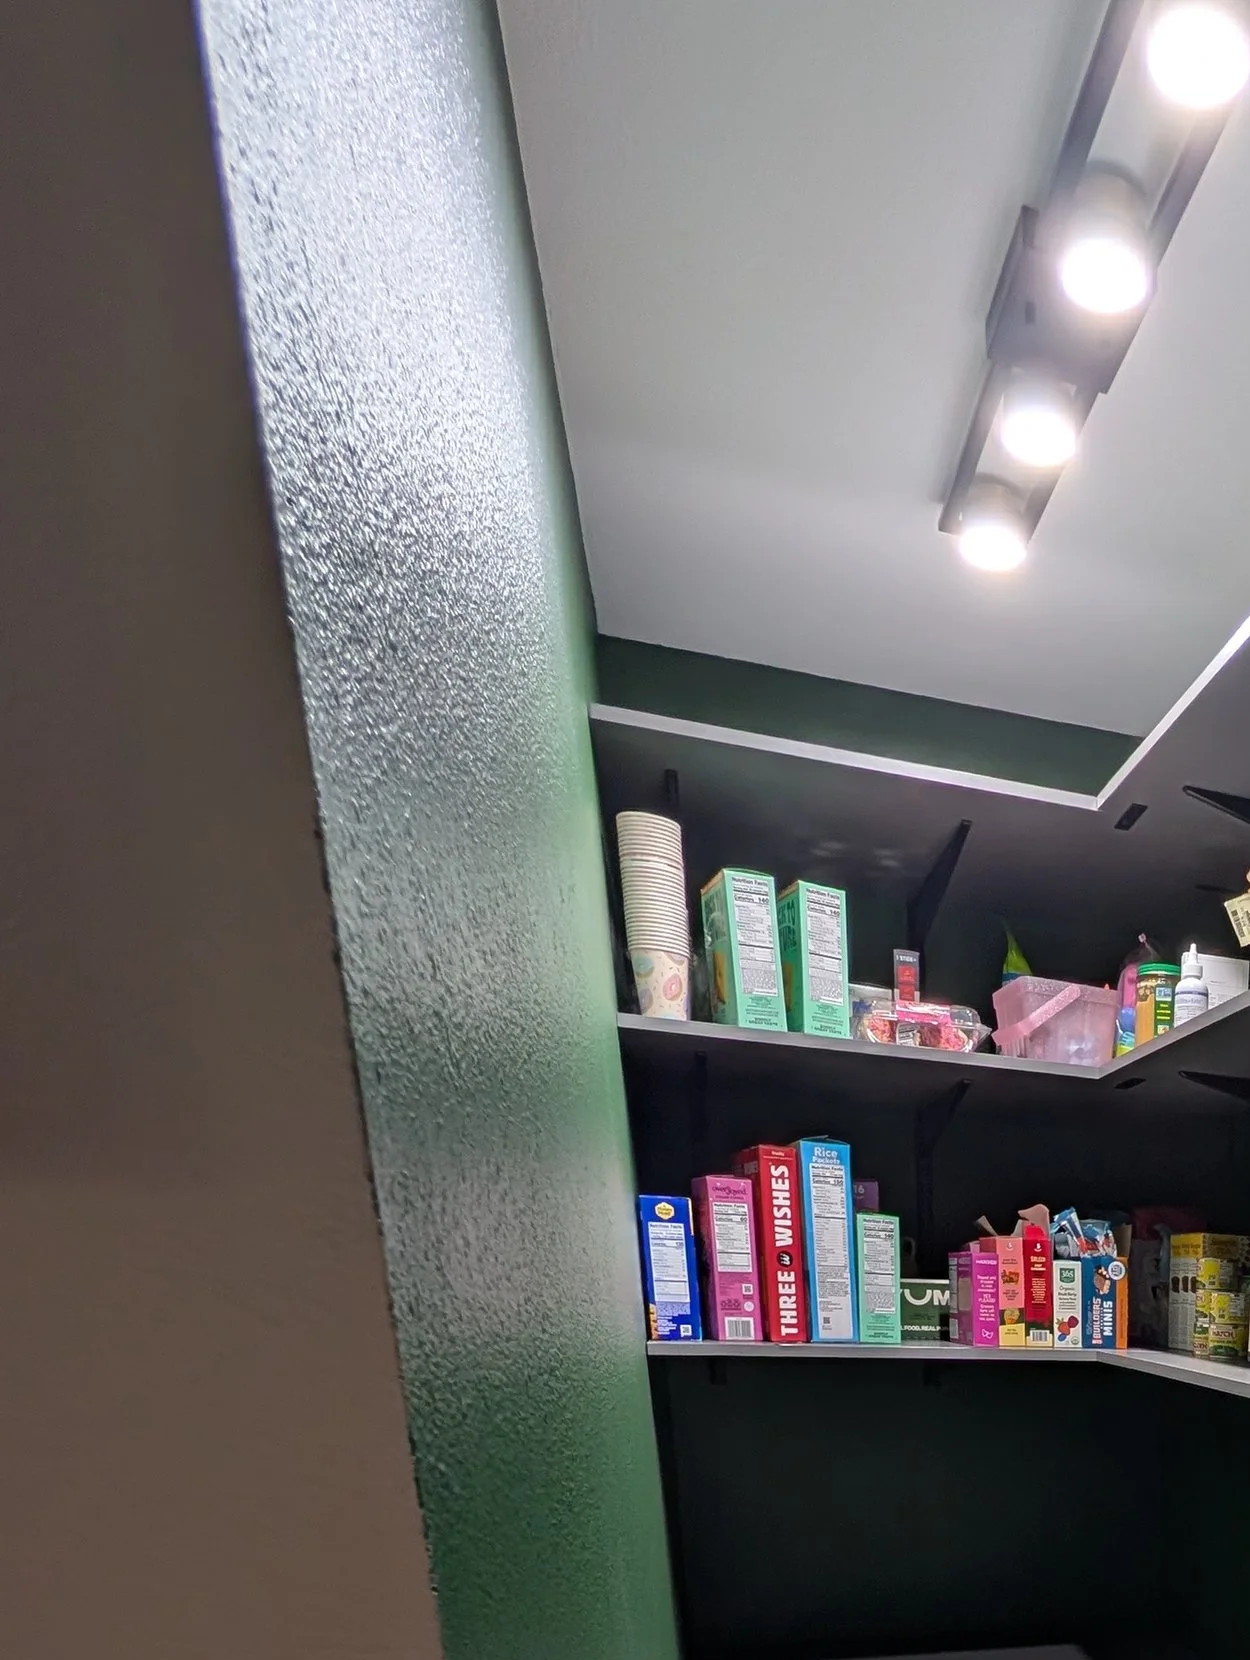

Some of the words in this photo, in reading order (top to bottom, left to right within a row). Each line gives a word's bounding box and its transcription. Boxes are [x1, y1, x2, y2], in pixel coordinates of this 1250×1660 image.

[813, 1146, 838, 1158] Rice
[770, 1164, 793, 1248] WISHES
[1060, 1270, 1075, 1278] 365
[777, 1270, 799, 1337] THREE
[900, 1289, 950, 1306] UM
[1092, 1296, 1102, 1340] BUILDERS
[1102, 1300, 1113, 1336] MINIS
